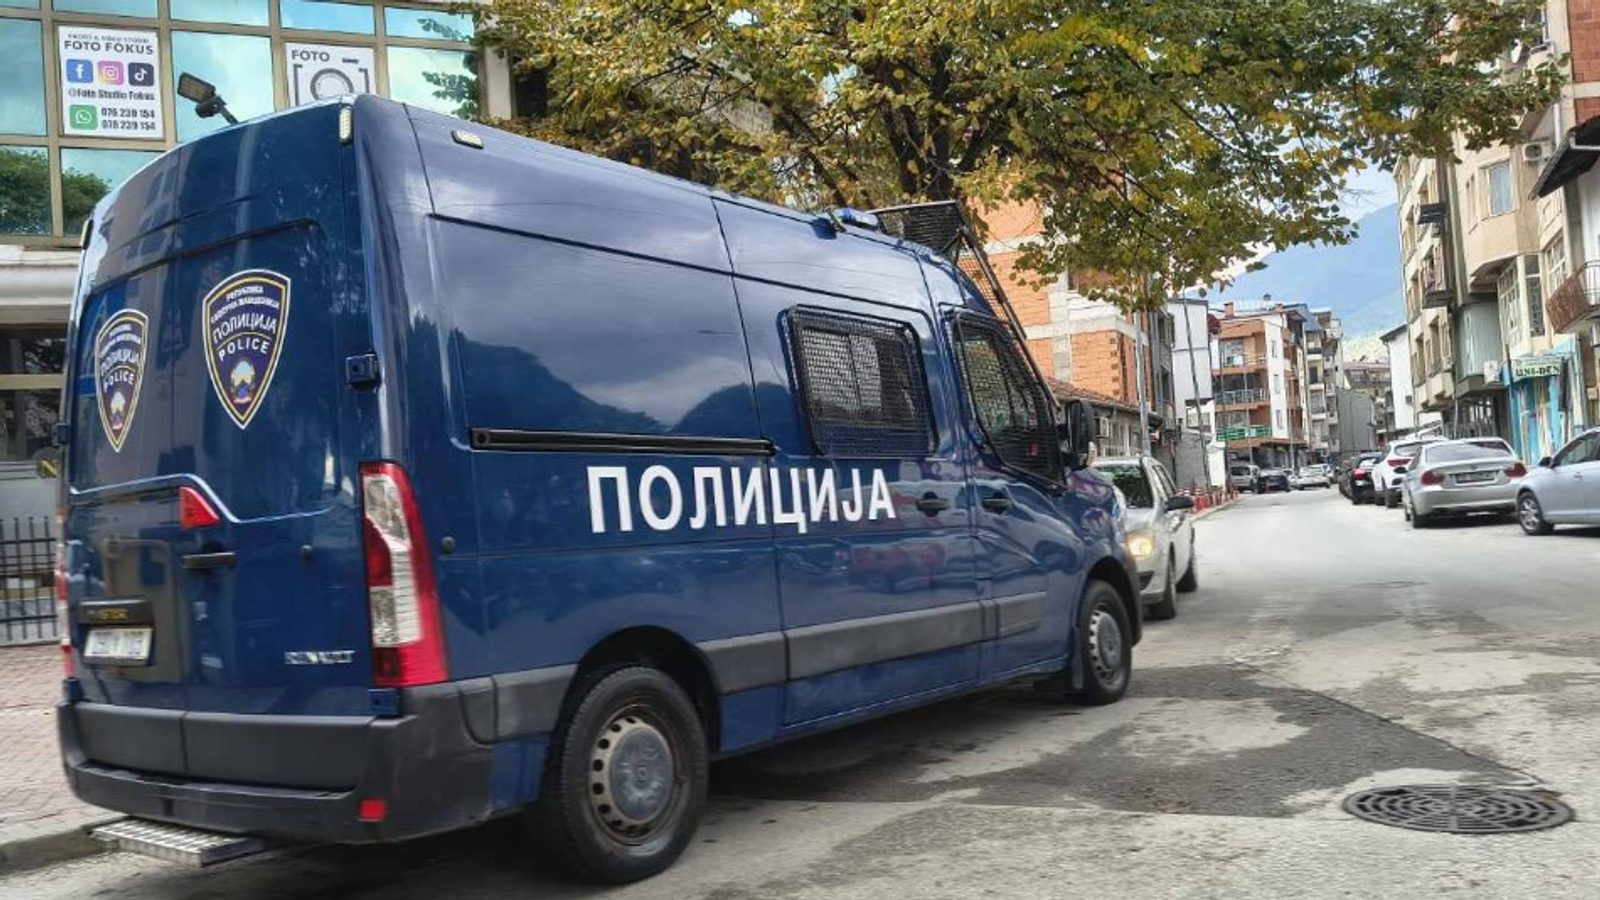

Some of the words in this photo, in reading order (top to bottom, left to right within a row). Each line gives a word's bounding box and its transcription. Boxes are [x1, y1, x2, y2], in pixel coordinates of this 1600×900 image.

[64, 40, 101, 51] FOTO
[105, 42, 154, 55] FOKUS
[291, 50, 330, 62] FOTO
[212, 312, 277, 344] ПОЛИЦИЈА
[218, 337, 270, 362] POLICE
[103, 369, 135, 393] POLICE
[587, 464, 896, 533] ПОЛИЦИЈА
